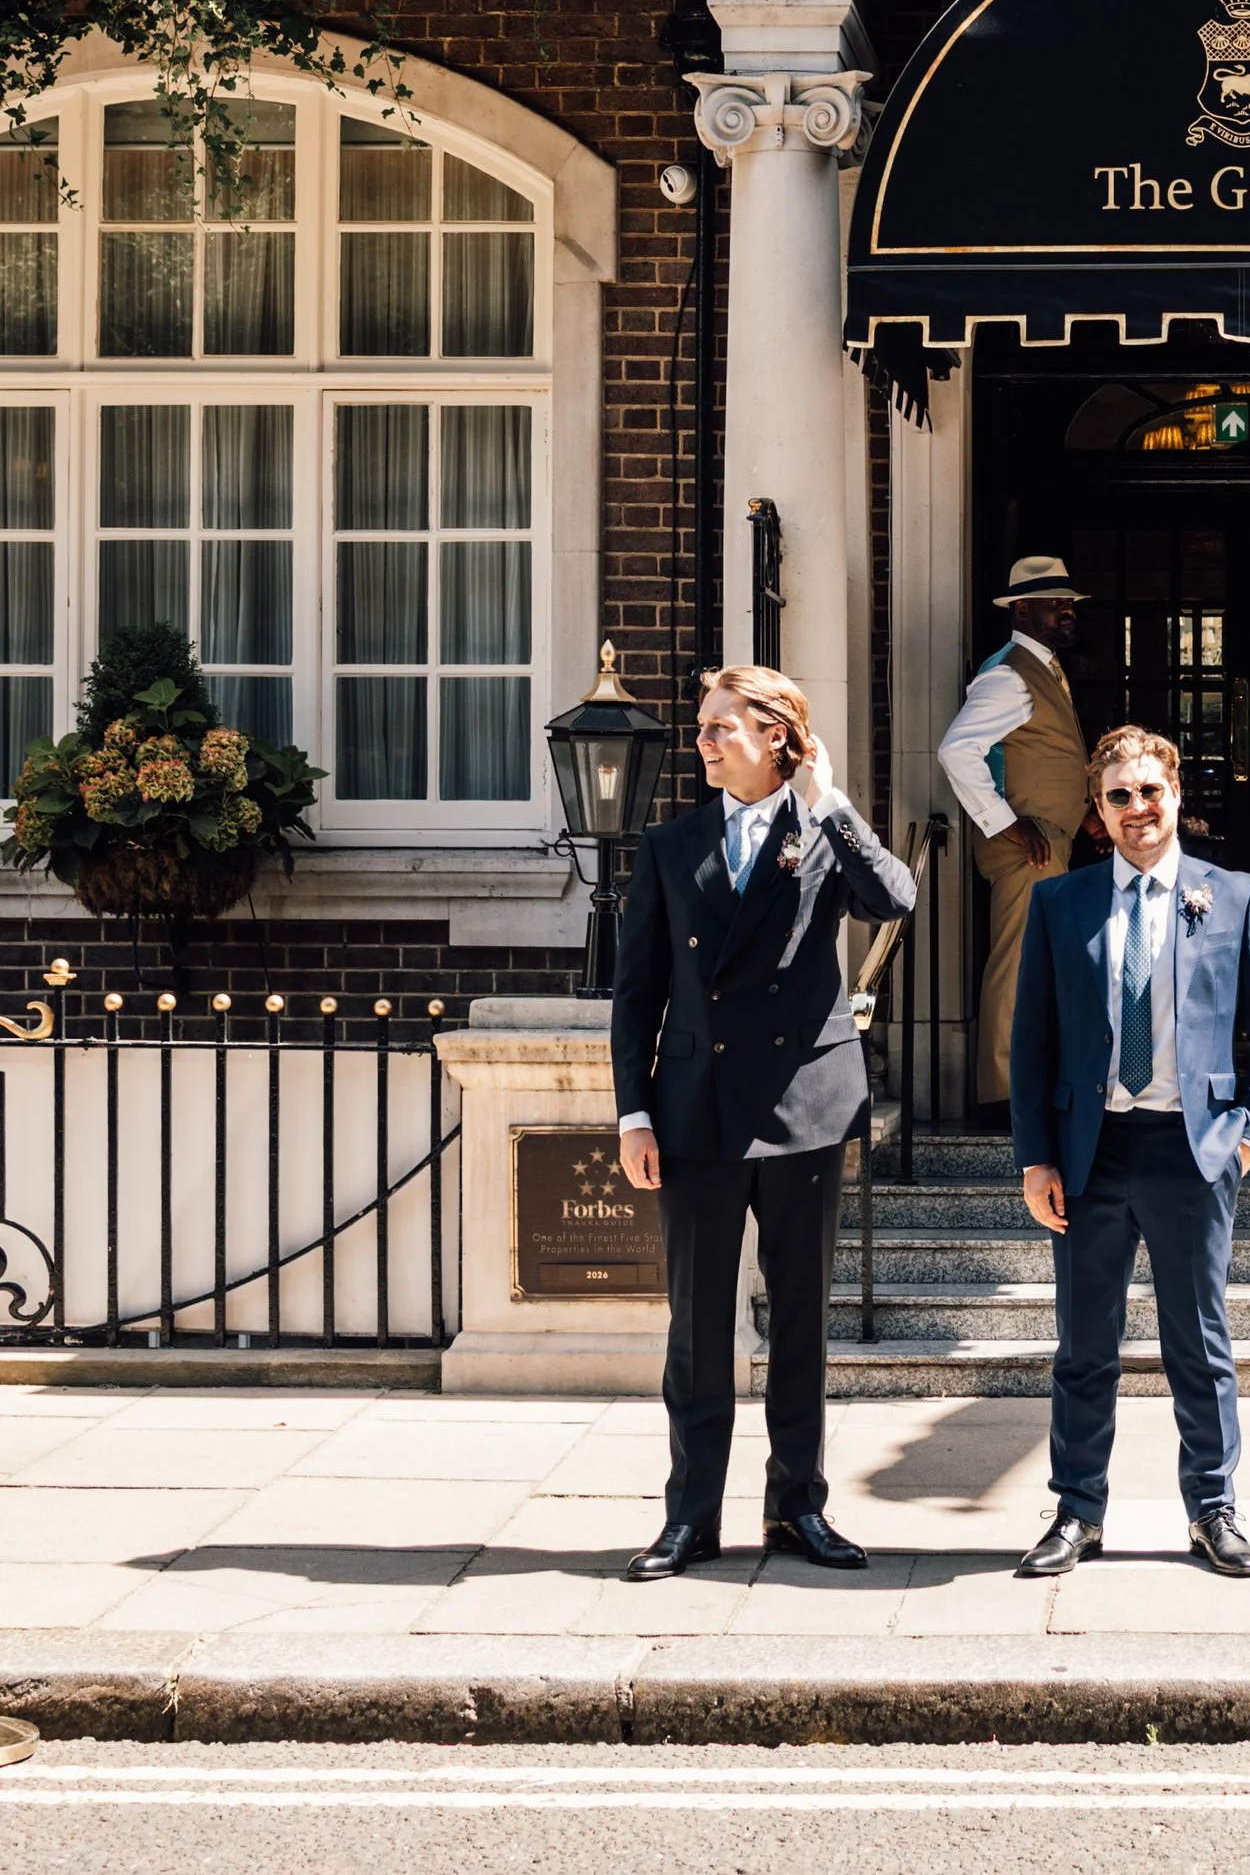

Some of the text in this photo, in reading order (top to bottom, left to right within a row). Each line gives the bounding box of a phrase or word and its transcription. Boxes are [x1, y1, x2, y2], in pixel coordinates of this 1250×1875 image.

[1209, 122, 1216, 130] E
[1217, 127, 1250, 144] VIRIBUS
[1094, 162, 1194, 210] The
[561, 1199, 635, 1219] Forbes
[532, 1233, 553, 1243] One
[556, 1231, 567, 1243] of
[570, 1233, 585, 1243] the
[588, 1233, 618, 1243] Finest
[620, 1233, 640, 1243] Five
[540, 1244, 656, 1256] Properties in the World
[586, 1271, 609, 1279] 2026
